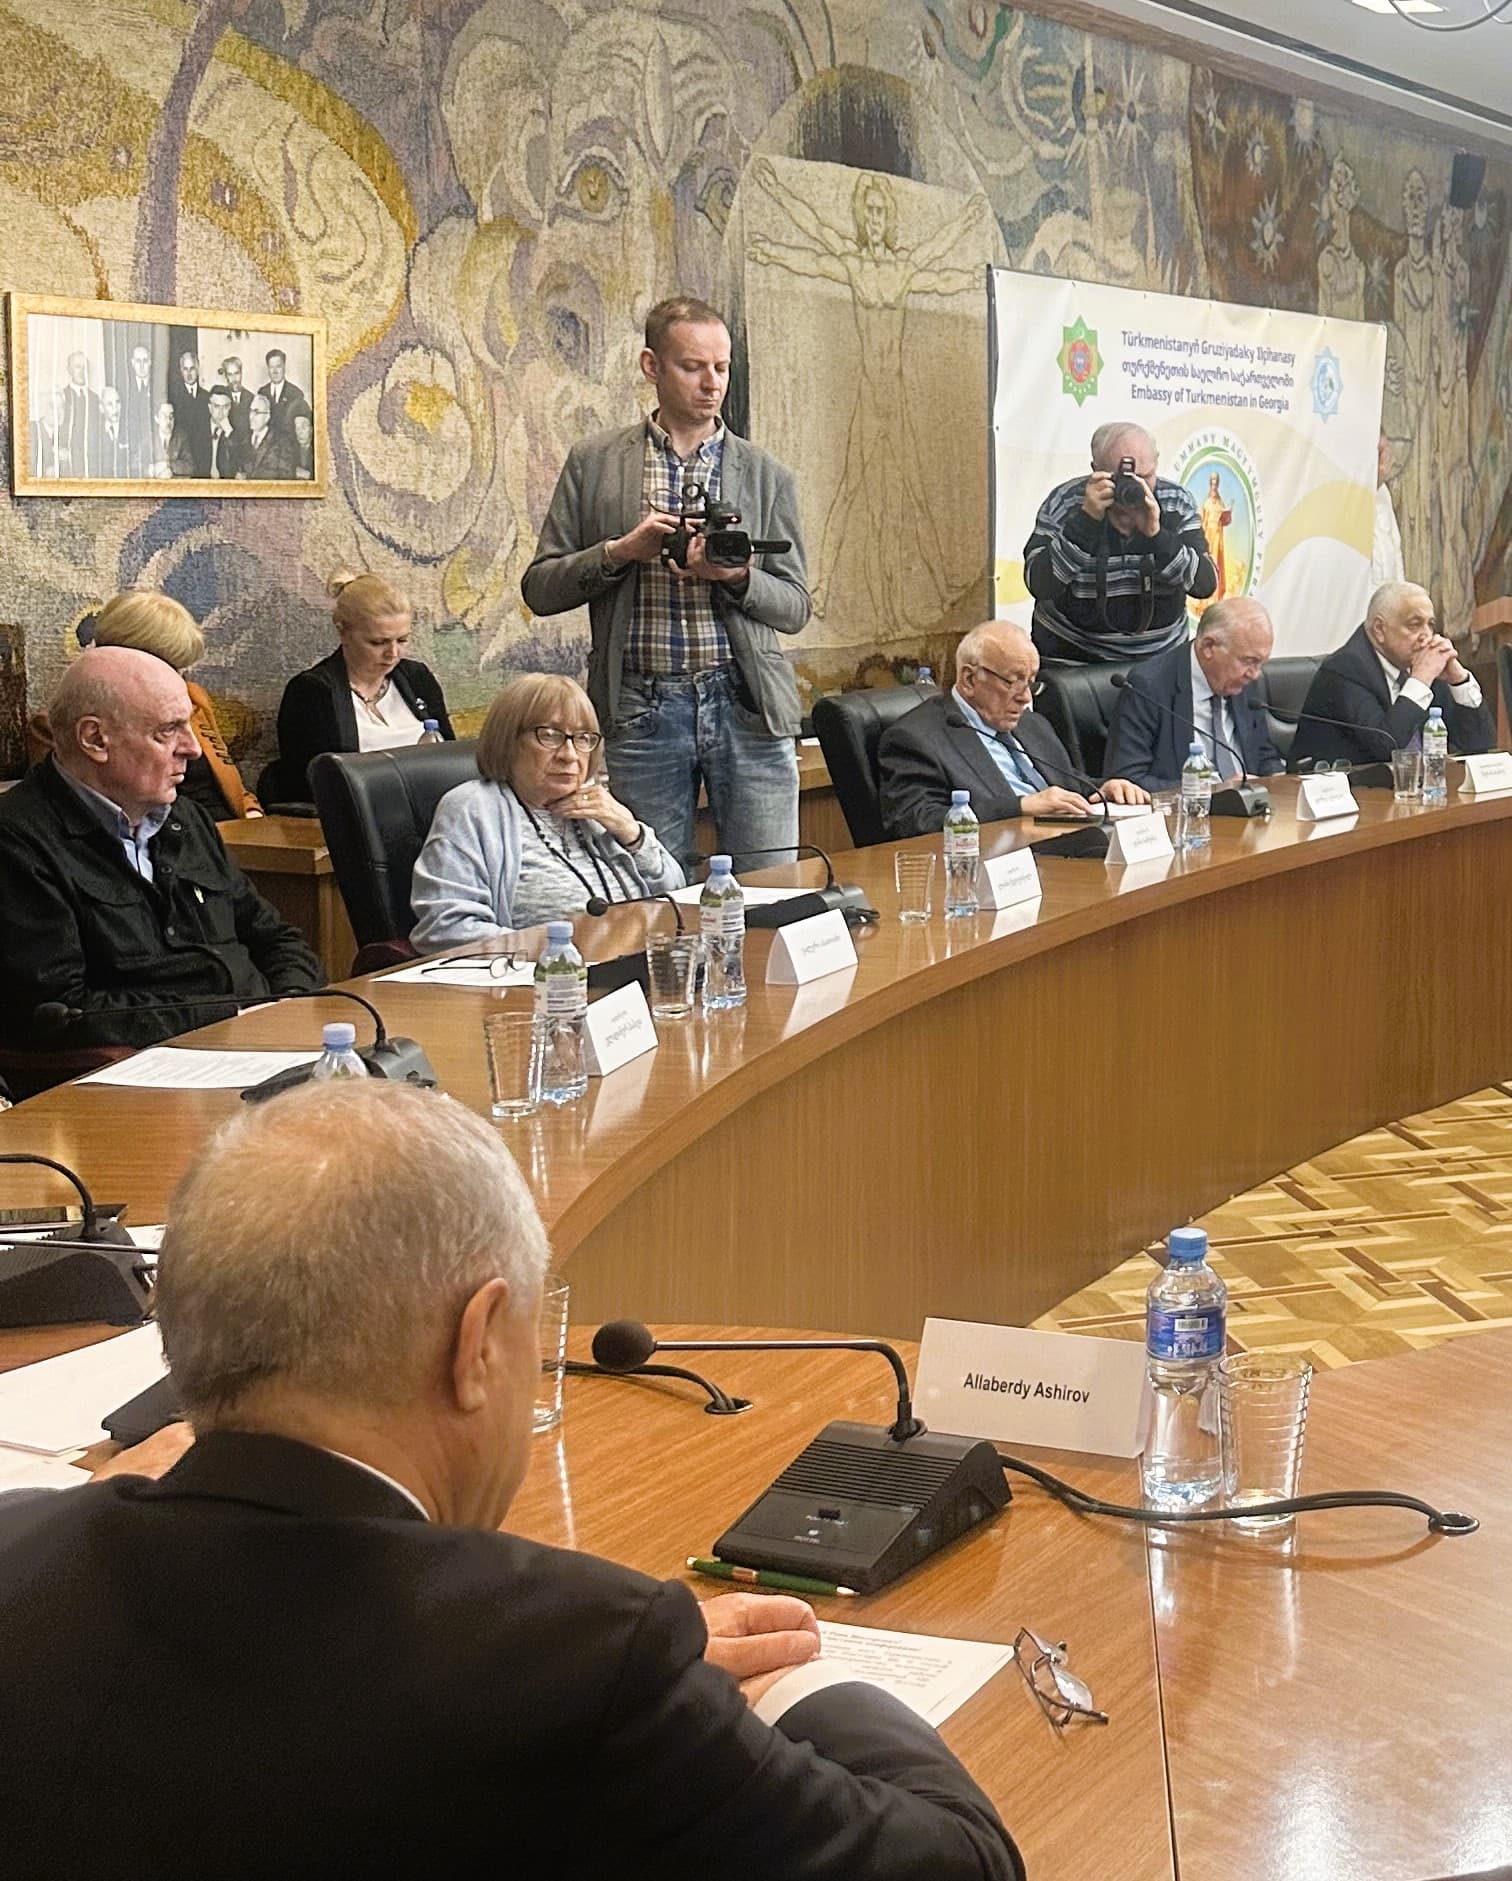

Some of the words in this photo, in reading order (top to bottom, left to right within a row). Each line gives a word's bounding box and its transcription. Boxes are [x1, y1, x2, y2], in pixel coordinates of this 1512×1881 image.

[1132, 384, 1172, 405] Embassy
[1175, 388, 1184, 402] of
[1186, 388, 1248, 408] Turkmenistan
[1250, 394, 1257, 408] in
[1259, 395, 1289, 413] Georgia
[963, 1372, 1031, 1400] Allaberdy
[1033, 1382, 1090, 1403] Ashirov
